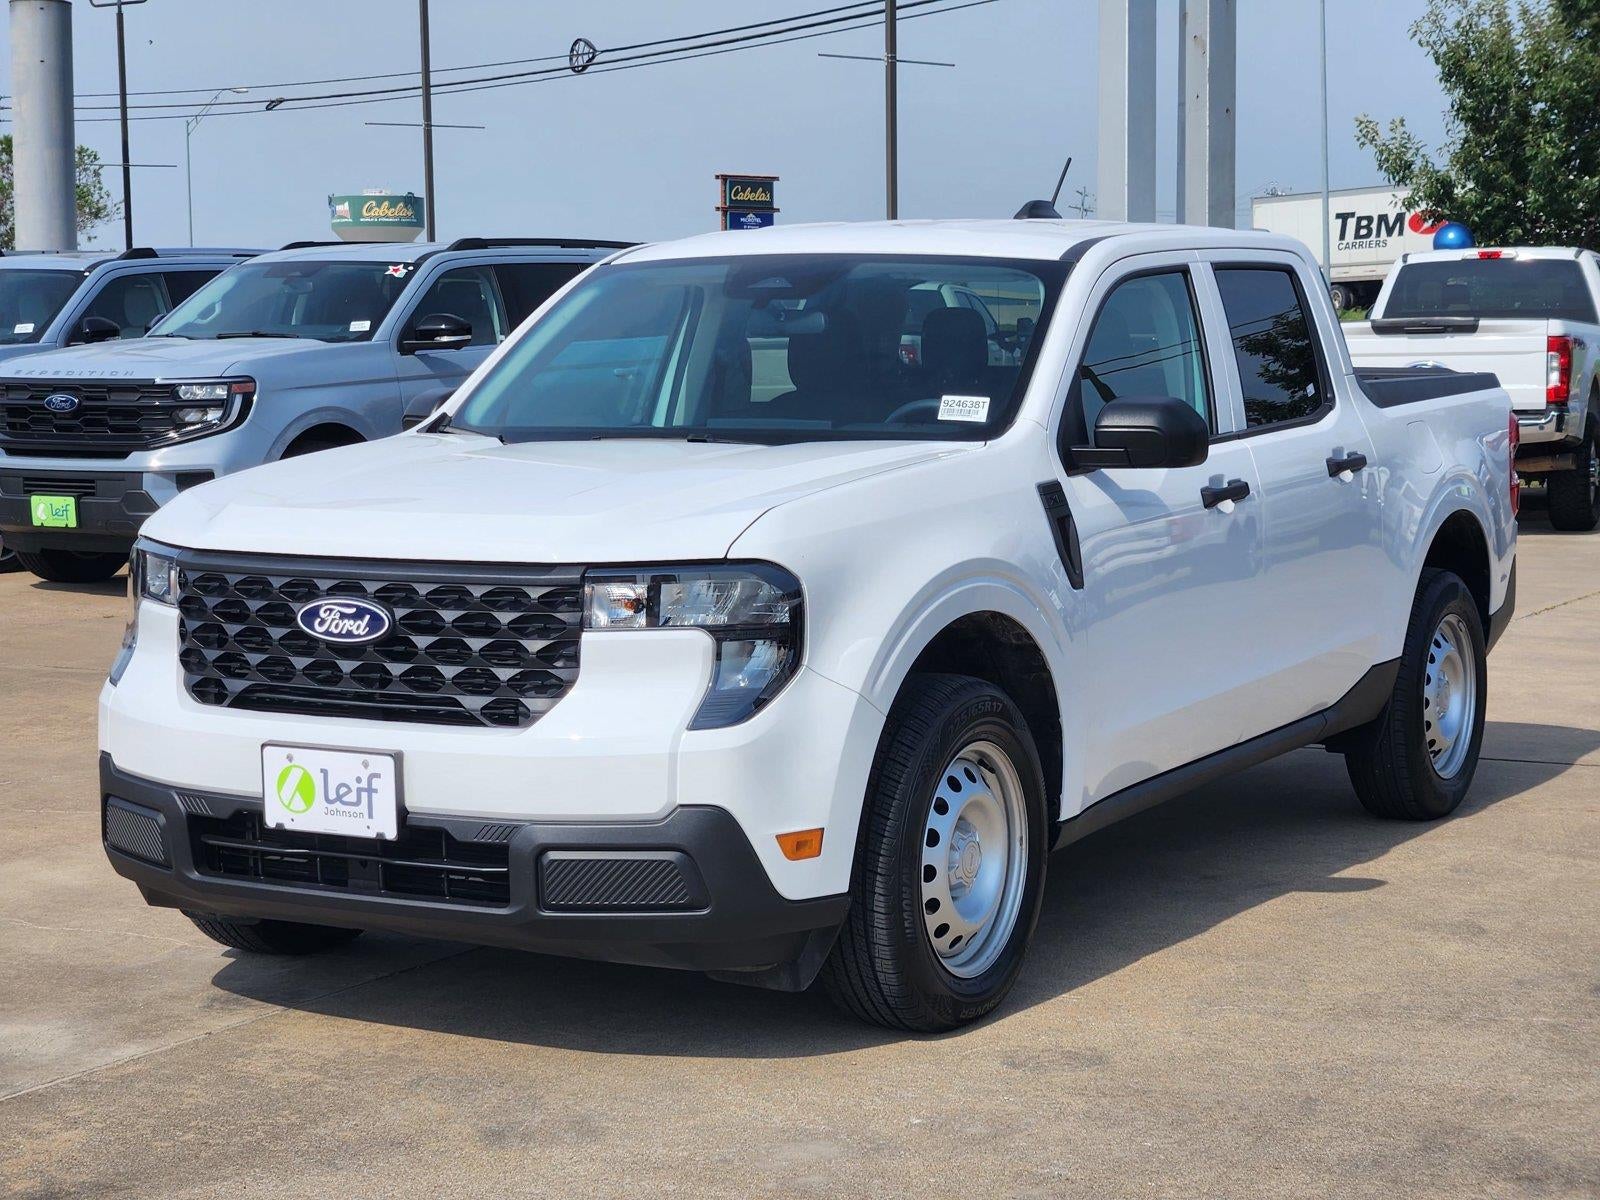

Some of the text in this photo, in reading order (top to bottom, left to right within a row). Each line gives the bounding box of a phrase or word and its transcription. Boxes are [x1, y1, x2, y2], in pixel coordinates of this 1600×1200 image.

[731, 185, 770, 201] Cabela's
[1335, 211, 1406, 241] TBM
[1337, 239, 1388, 251] CARRIERS
[50, 396, 72, 409] Ford
[943, 399, 987, 410] 924638T
[314, 605, 370, 635] Ford
[320, 768, 381, 819] leif
[323, 806, 364, 819] Johnson
